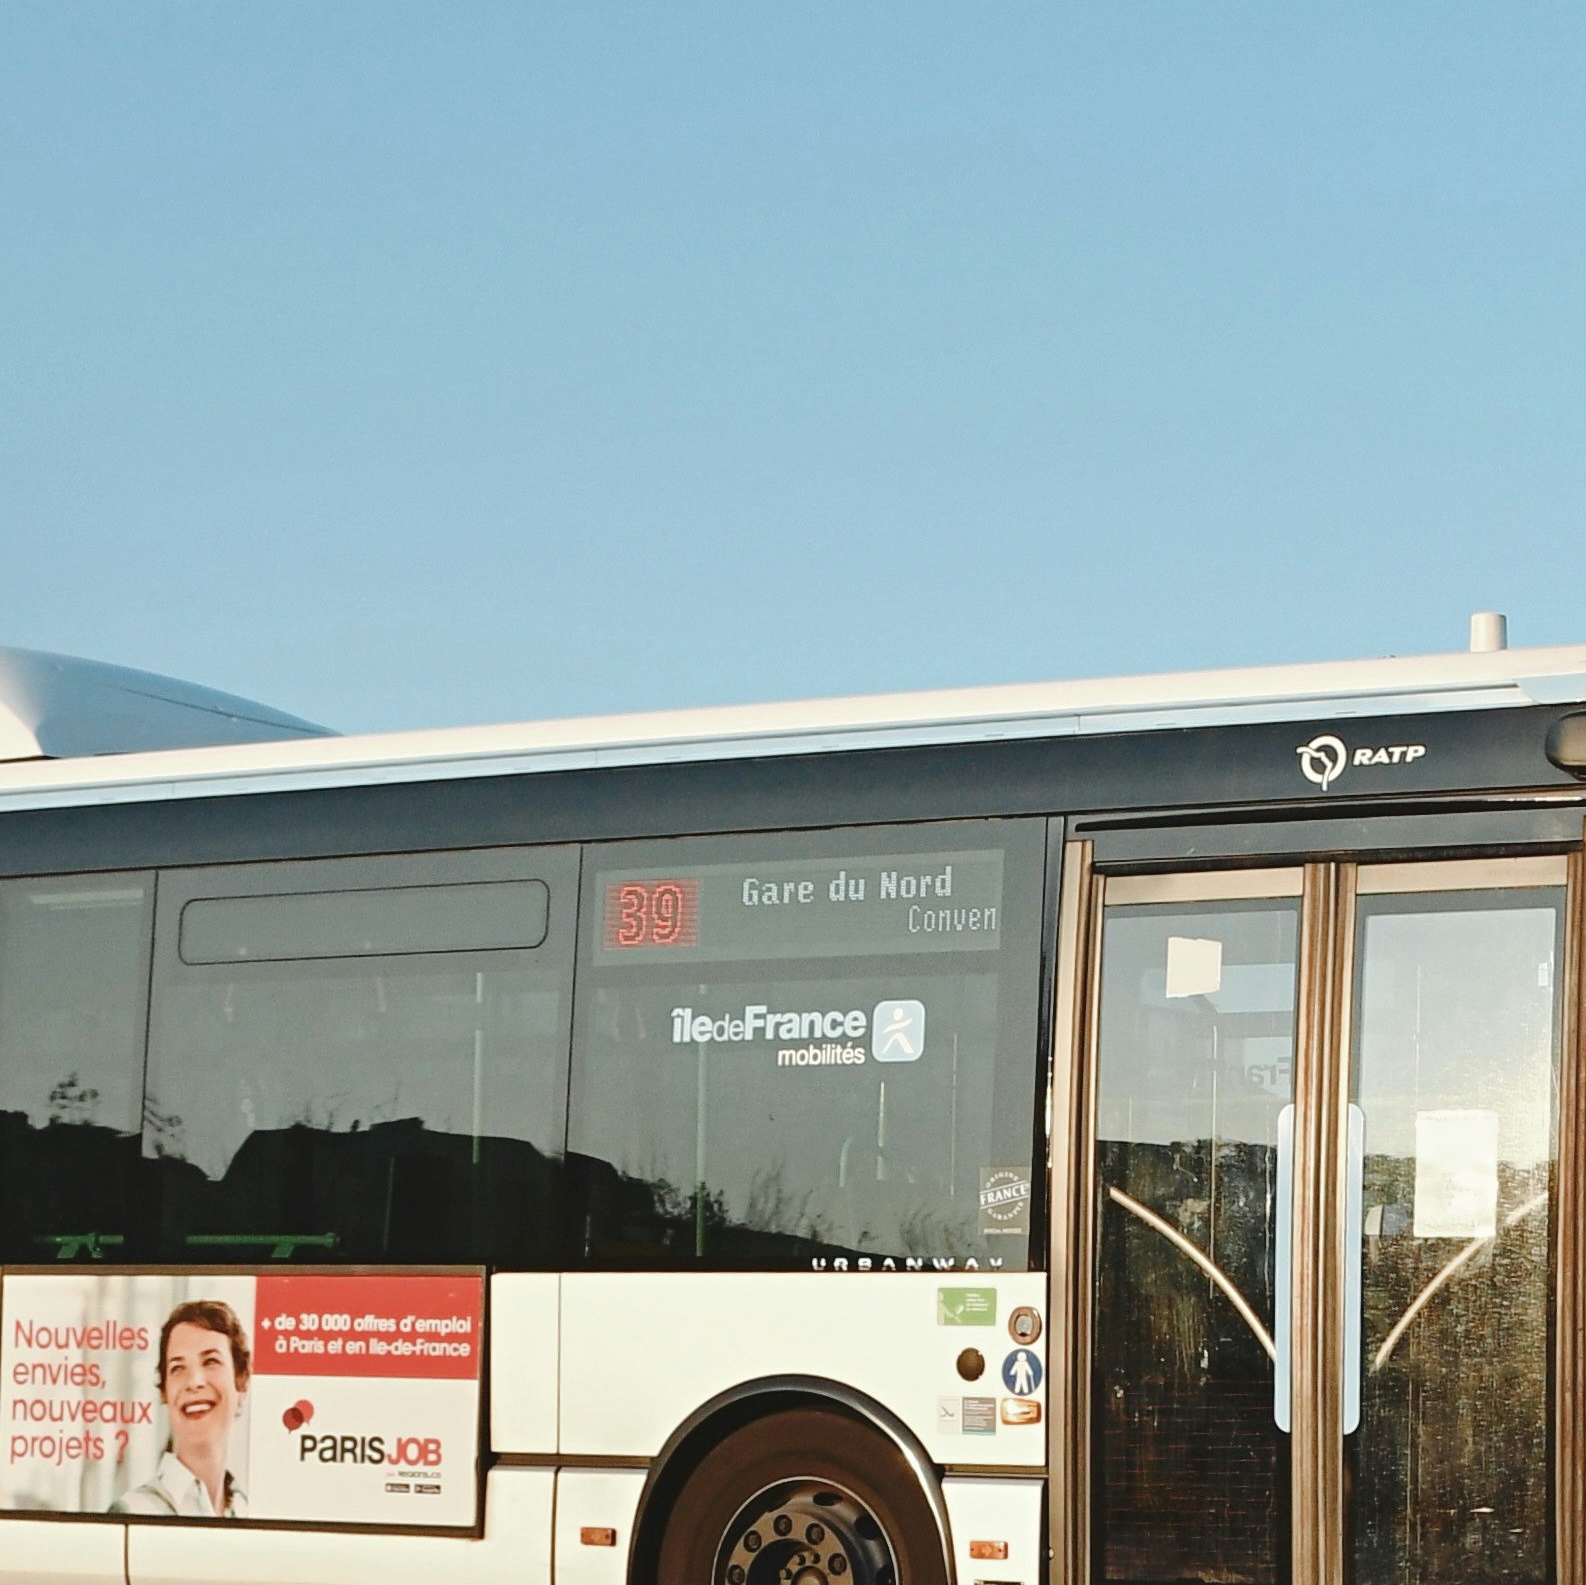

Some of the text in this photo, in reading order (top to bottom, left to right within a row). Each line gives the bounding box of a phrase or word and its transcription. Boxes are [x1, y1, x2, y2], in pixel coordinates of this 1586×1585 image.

[1352, 744, 1427, 767] RATP
[742, 865, 953, 907] Gare du Nord
[617, 882, 685, 946] 39
[907, 904, 997, 934] Conven
[777, 1041, 866, 1066] mobilités
[979, 1183, 1028, 1206] FRANCE
[812, 1257, 1003, 1271] URBANWAY
[14, 1319, 149, 1351] Nouvelles
[274, 1313, 296, 1331] de
[299, 1313, 319, 1331] 30
[321, 1313, 352, 1331] 000
[354, 1314, 397, 1332] offres
[399, 1315, 472, 1336] d'emploi
[275, 1335, 471, 1357] à Paris et en Ile-de-France
[13, 1356, 107, 1389] envies,
[12, 1398, 153, 1425] nouveaux
[10, 1428, 130, 1466] projets ?
